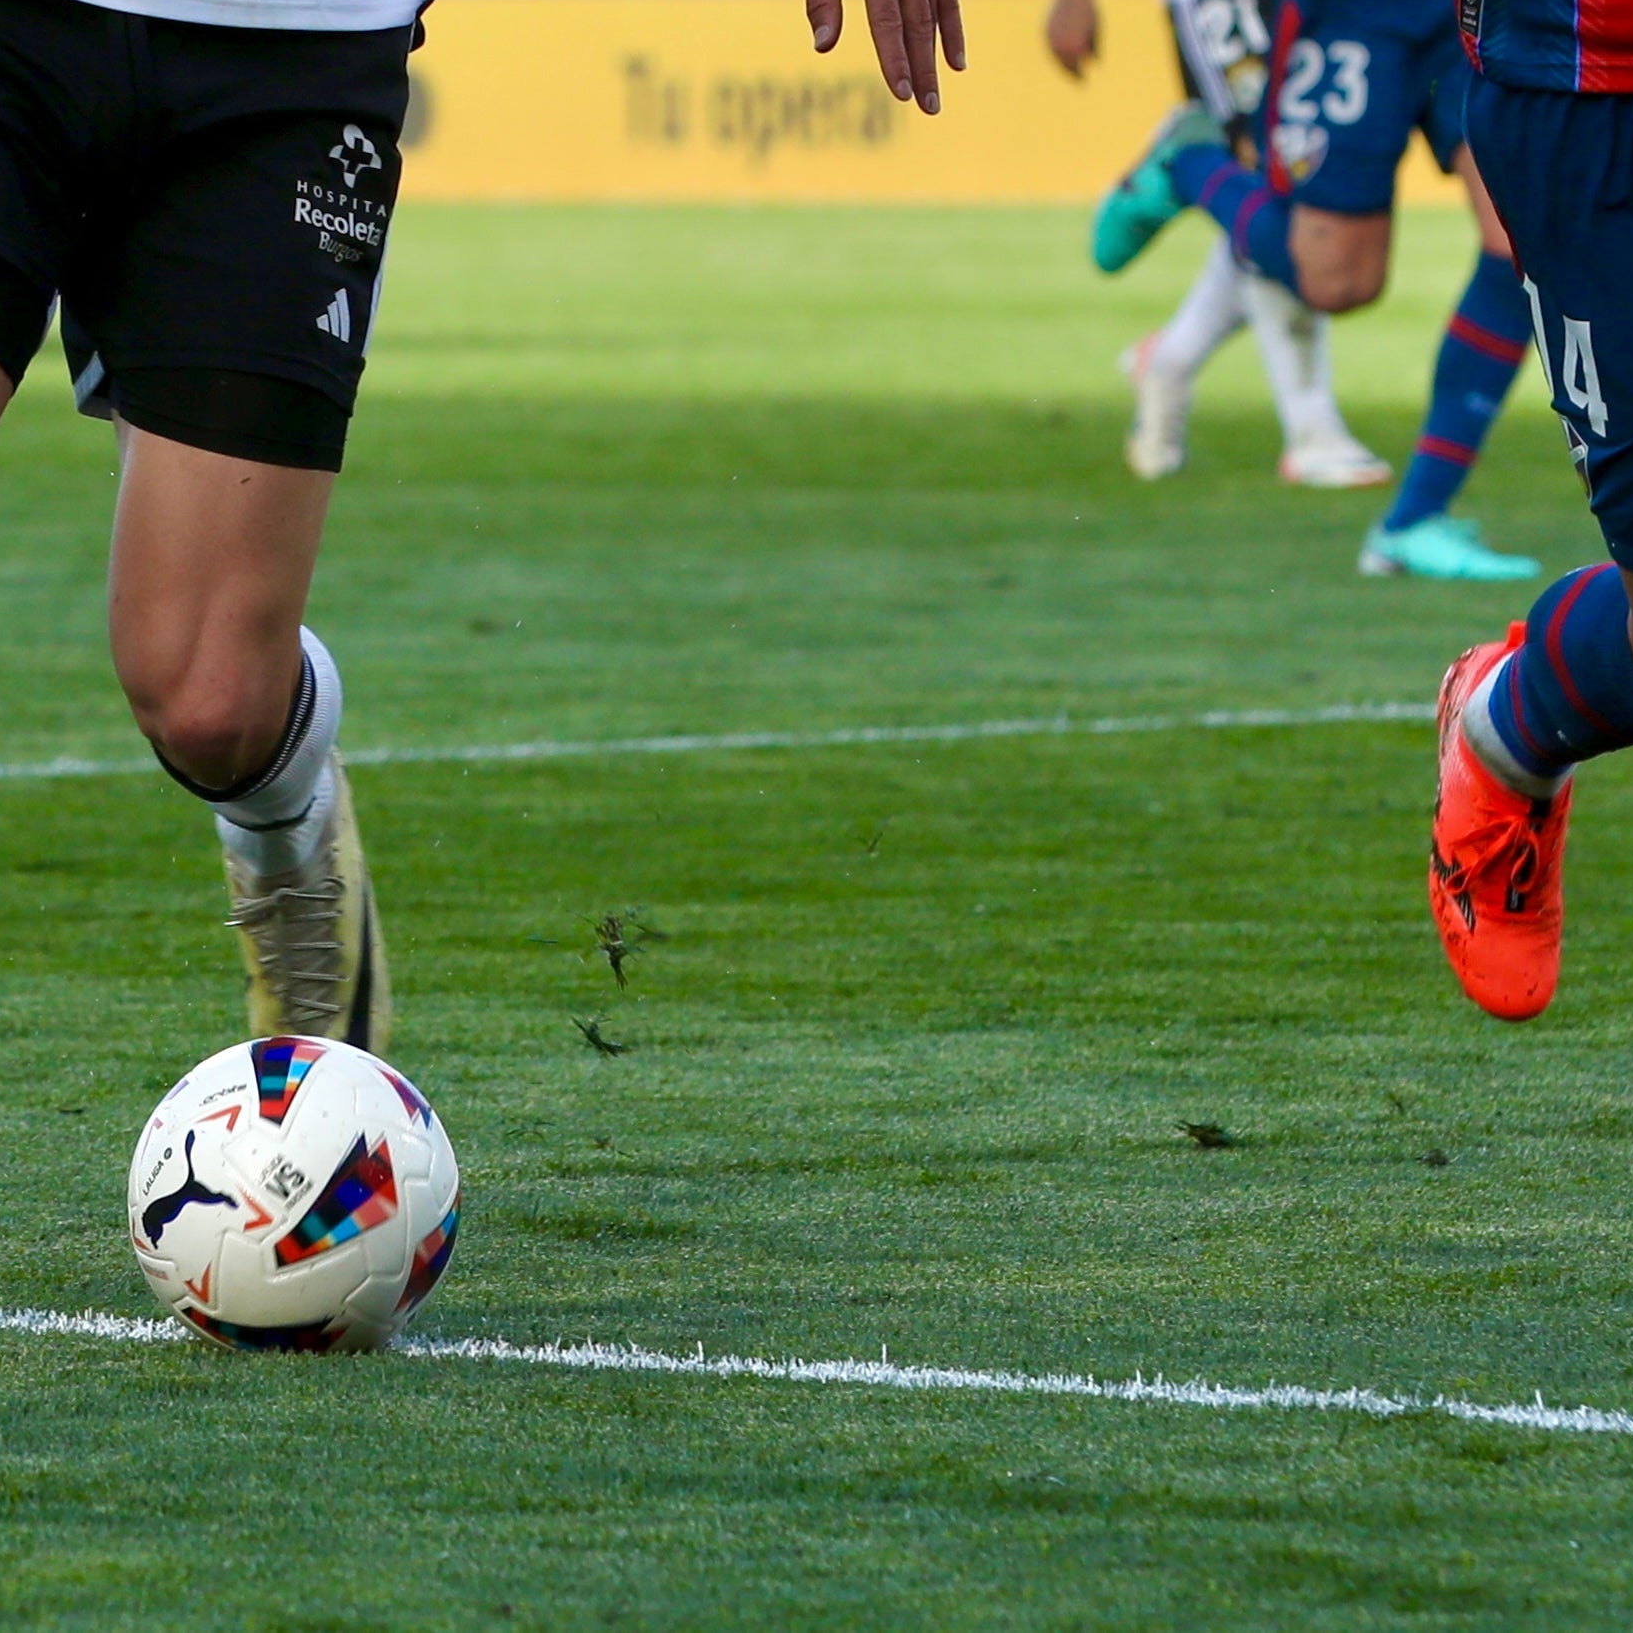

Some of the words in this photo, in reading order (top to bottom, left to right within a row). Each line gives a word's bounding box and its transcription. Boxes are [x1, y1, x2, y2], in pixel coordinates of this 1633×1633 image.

[621, 54, 690, 142] Tu
[1277, 38, 1371, 125] 23
[294, 197, 384, 247] Recoleta
[296, 180, 387, 217] HOSPITA
[319, 231, 364, 263] Burgos
